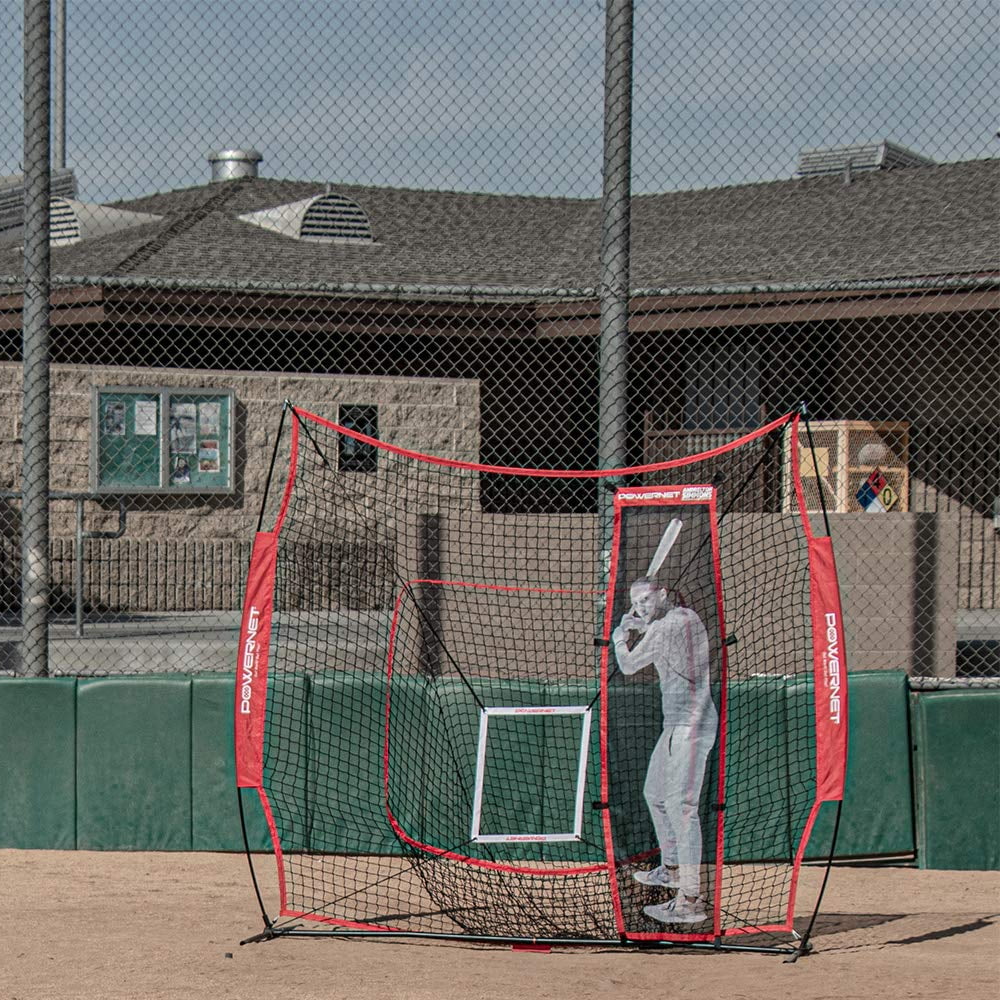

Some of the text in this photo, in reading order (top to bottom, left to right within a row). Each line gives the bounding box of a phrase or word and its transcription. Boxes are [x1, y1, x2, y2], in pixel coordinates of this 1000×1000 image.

[618, 491, 680, 500] POWERNET
[241, 606, 260, 714] POWERNET
[825, 613, 840, 724] POWERNET
